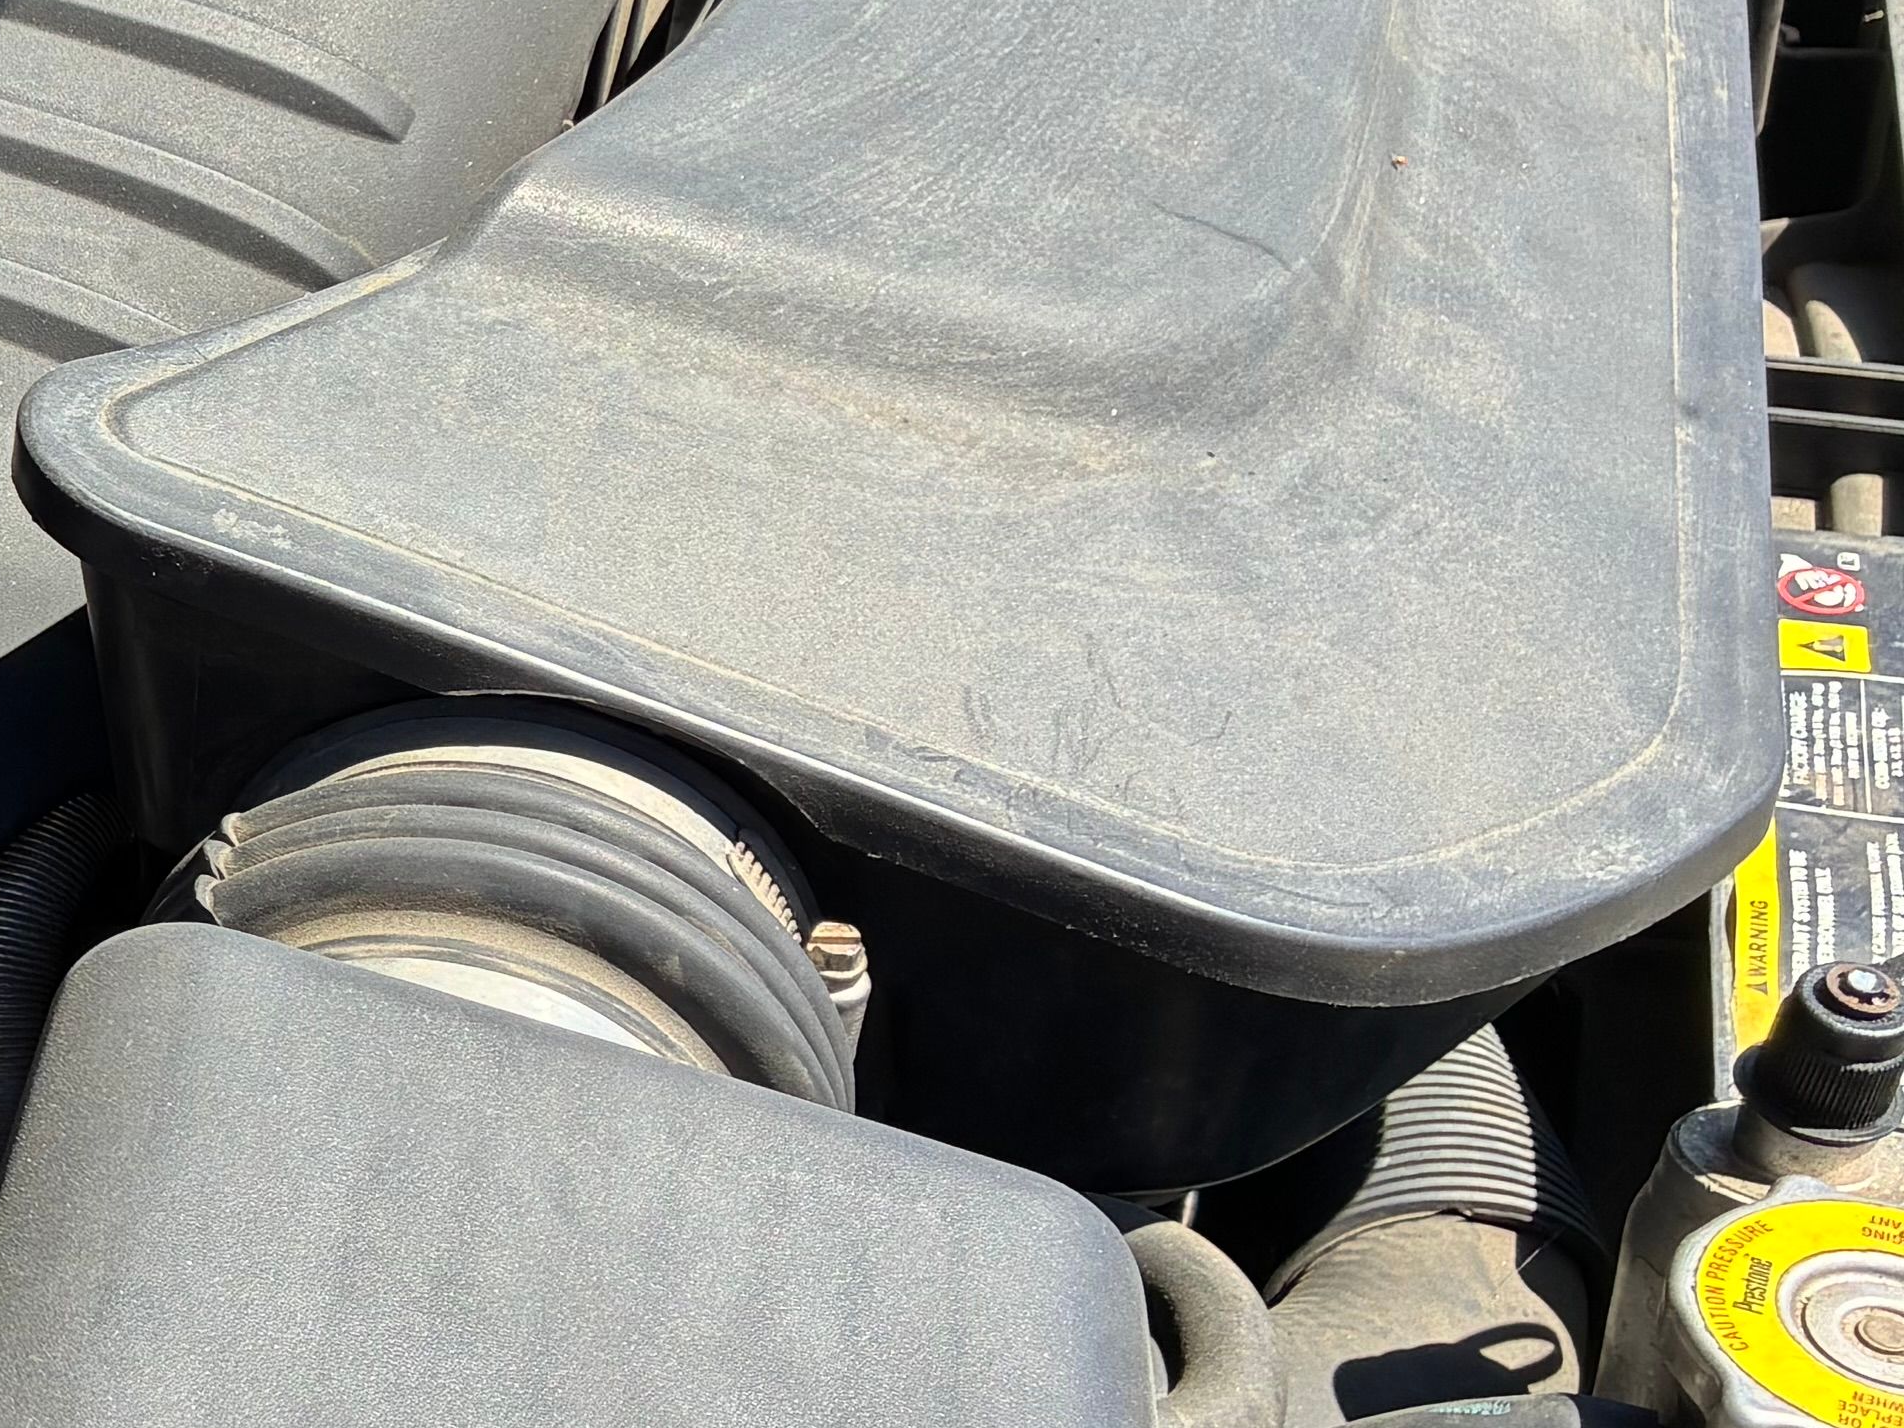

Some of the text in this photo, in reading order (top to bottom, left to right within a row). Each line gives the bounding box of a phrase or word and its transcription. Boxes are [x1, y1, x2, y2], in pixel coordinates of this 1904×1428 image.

[1748, 899, 1768, 975] WARNING
[1704, 1219, 1774, 1352] CAUTION PRESSURE
[1732, 1256, 1773, 1315] Prestone
[1837, 1399, 1904, 1427] EPLACE
